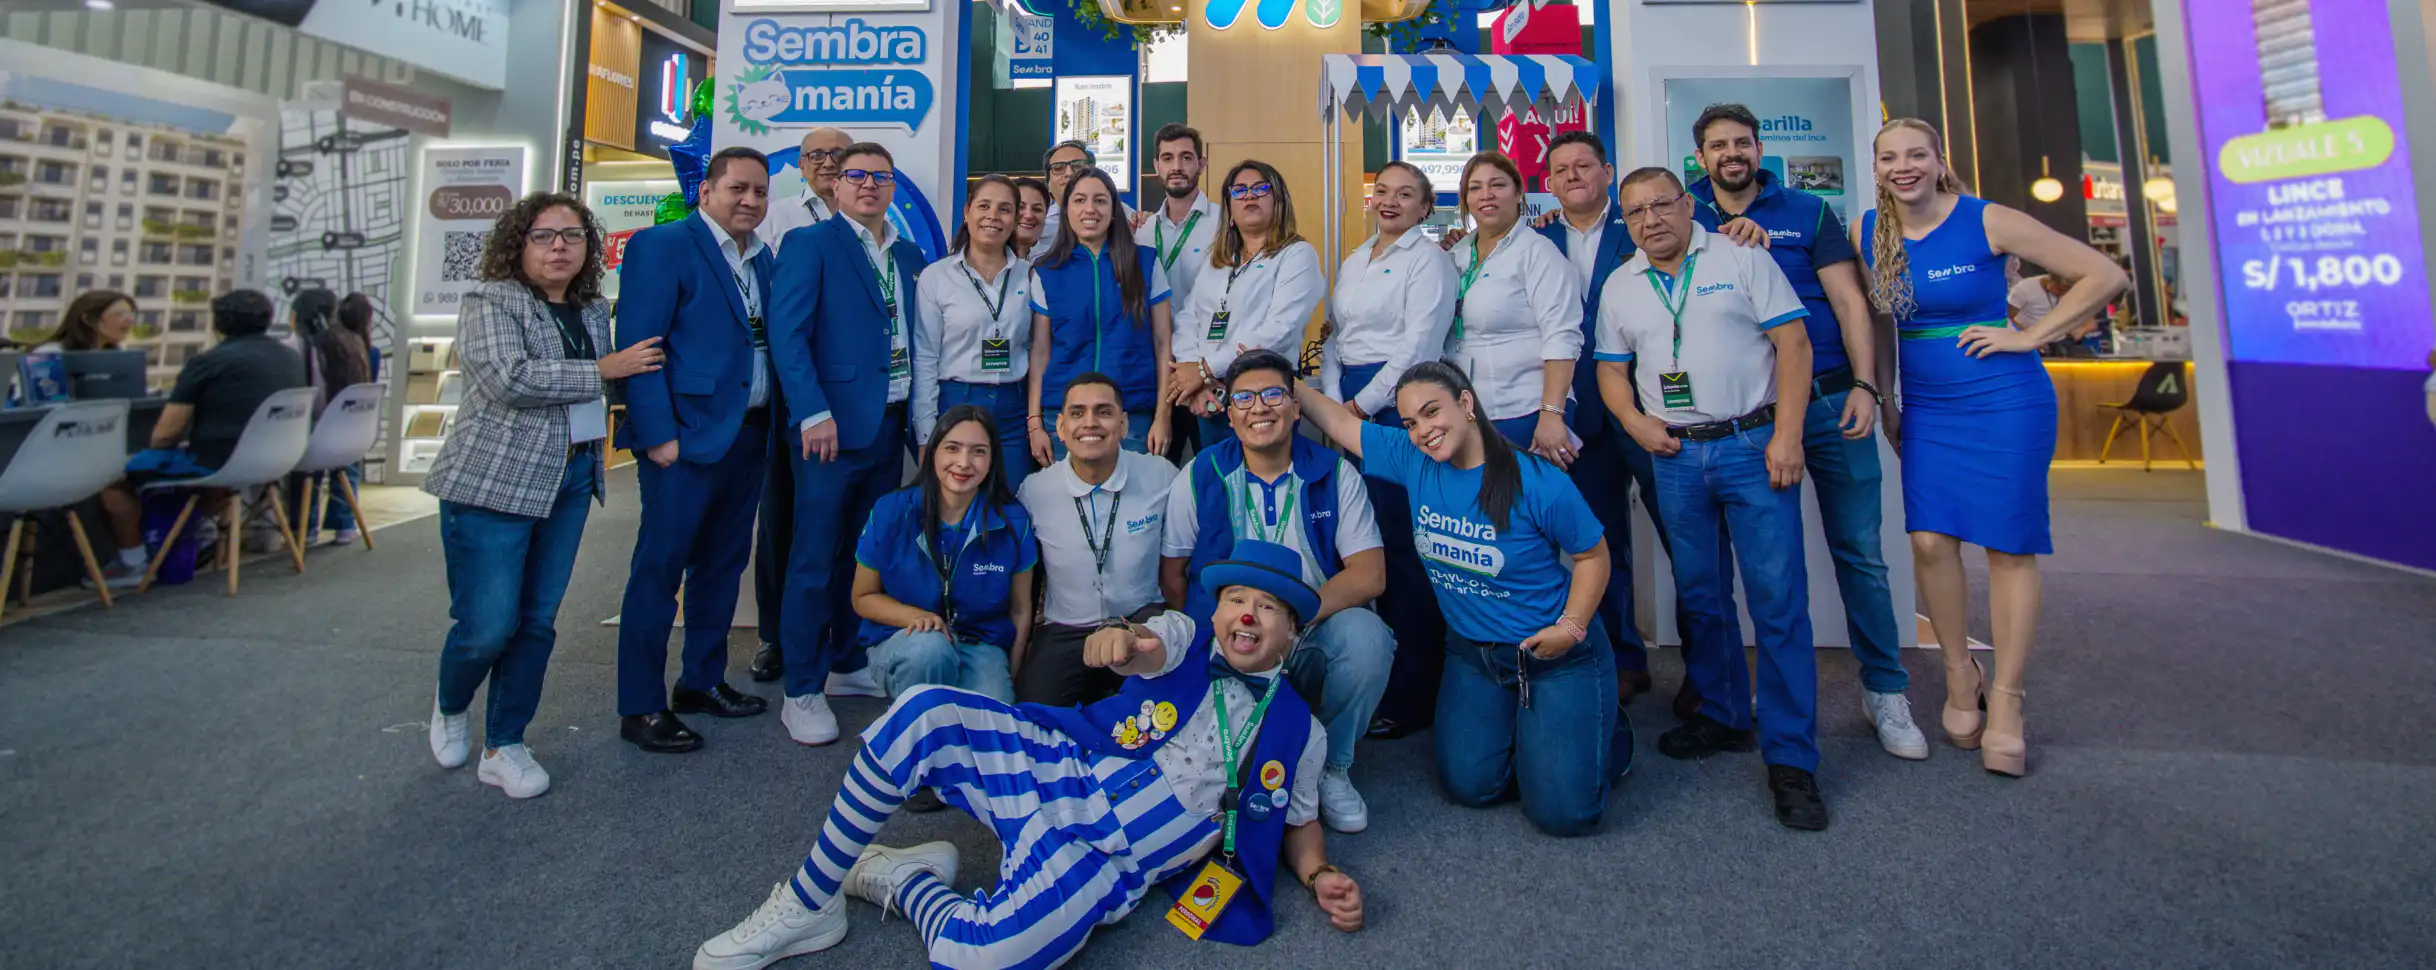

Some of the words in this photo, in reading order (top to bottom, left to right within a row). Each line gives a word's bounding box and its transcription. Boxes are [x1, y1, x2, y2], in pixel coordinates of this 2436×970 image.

[411, 0, 490, 45] HOME
[1028, 19, 1053, 28] AND
[748, 22, 922, 60] Sembra
[1034, 32, 1049, 41] 40
[1035, 44, 1047, 54] 41
[1013, 64, 1052, 73] Sembra
[794, 74, 916, 110] manía
[1759, 115, 1812, 132] arilla
[1759, 134, 1791, 142] aminos
[2267, 177, 2345, 206] LINCE
[448, 197, 504, 217] 30,000
[603, 194, 665, 206] DESCUEN
[623, 210, 634, 218] DE
[634, 209, 655, 217] HAST
[1768, 229, 1801, 238] Sembra
[1928, 264, 1975, 279] Sembra
[2242, 253, 2281, 291] S/
[2287, 253, 2402, 293] 1,800
[1696, 282, 1734, 294] Sembra
[2285, 300, 2360, 318] ORTIZ
[1126, 513, 1159, 530] Sembra
[1417, 504, 1497, 541] Sembra
[1432, 541, 1494, 567] manía
[972, 562, 1005, 573] Sembra
